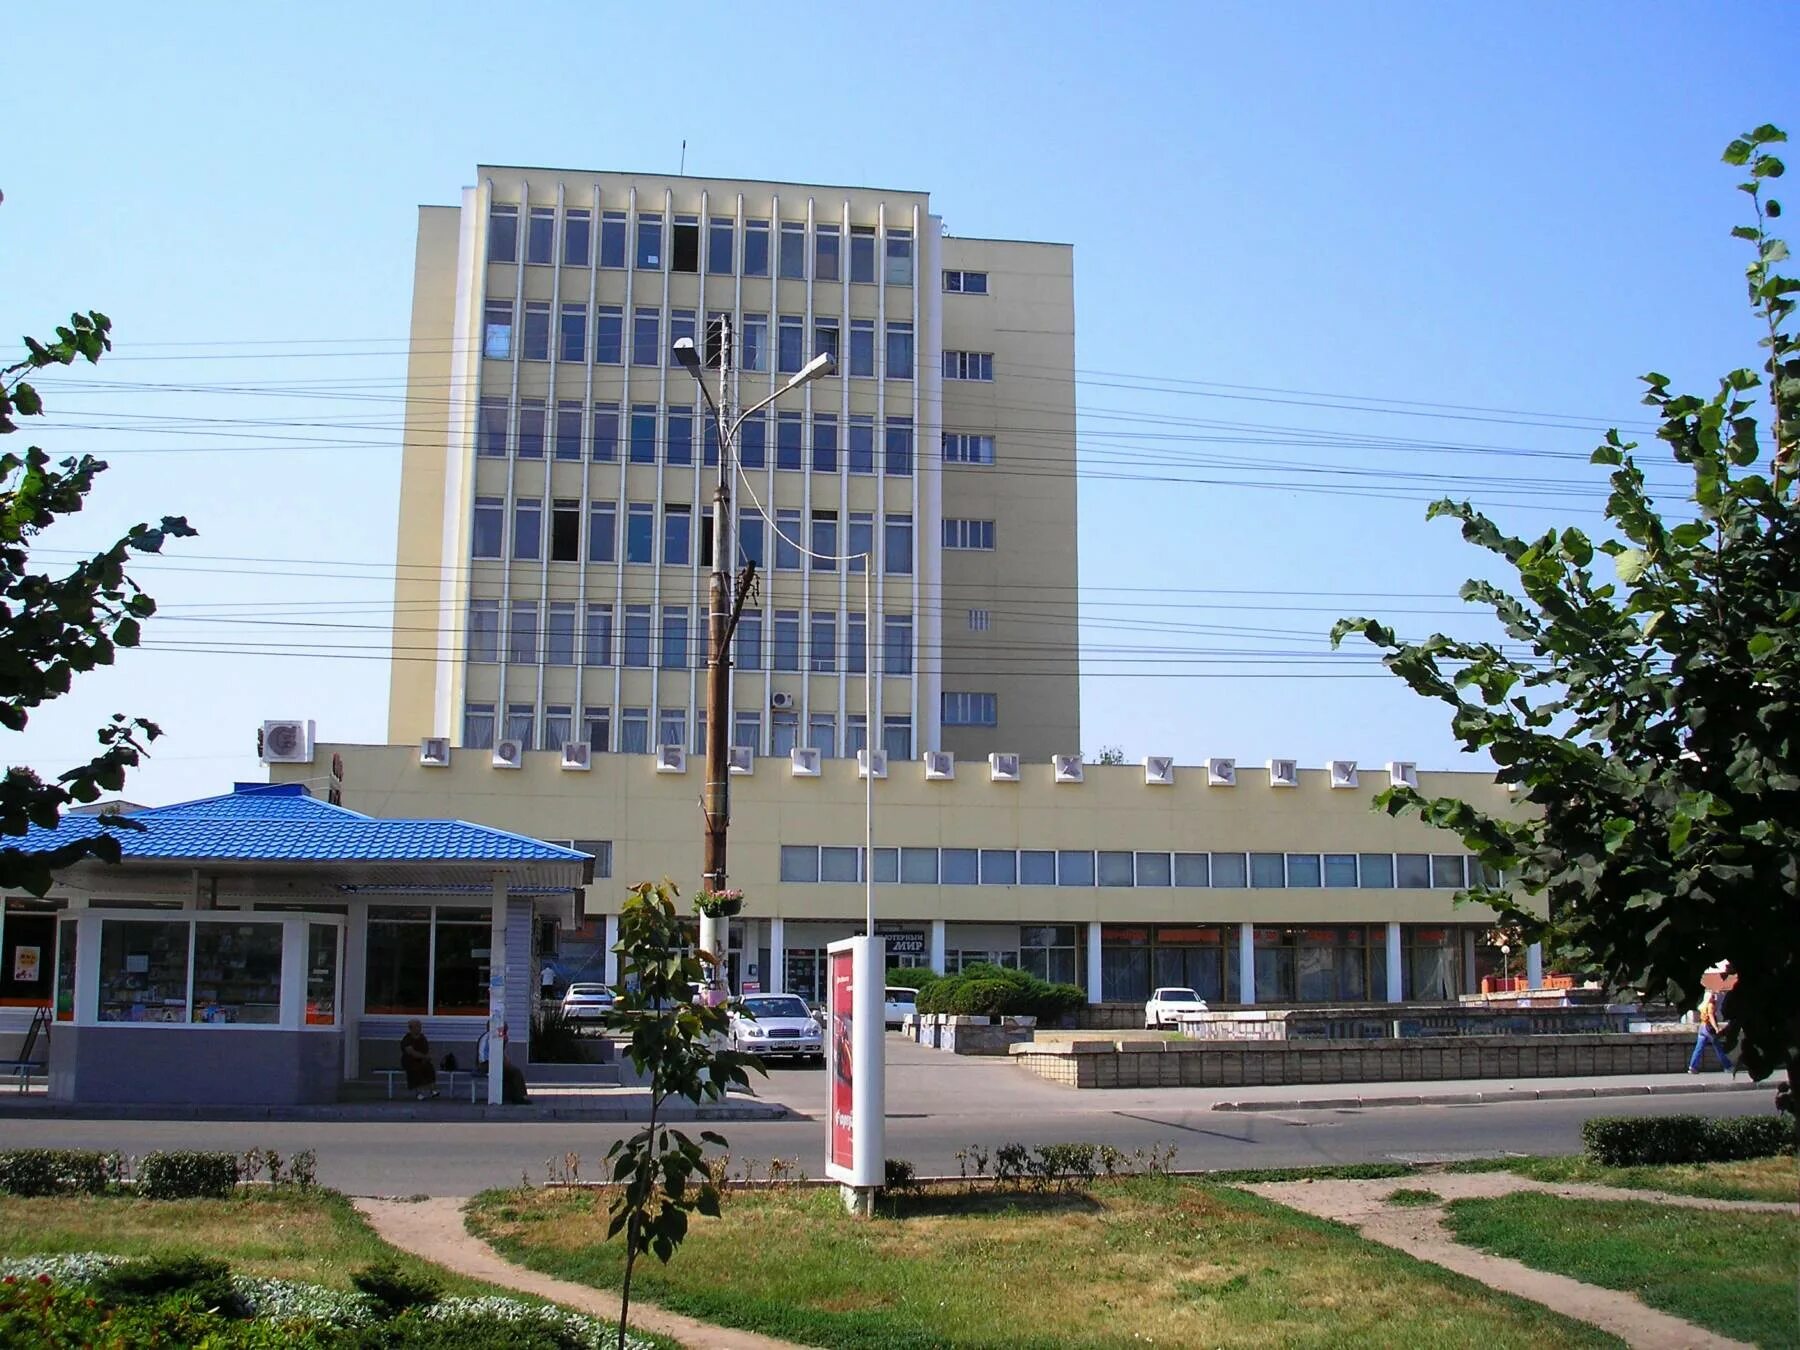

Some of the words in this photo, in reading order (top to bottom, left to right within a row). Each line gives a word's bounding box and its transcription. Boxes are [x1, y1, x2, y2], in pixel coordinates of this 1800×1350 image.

[424, 740, 587, 765] ДОМ
[663, 747, 1081, 777] БЫТОВЫХ
[1153, 758, 1414, 782] УСЛУГ
[893, 942, 922, 950] МИР
